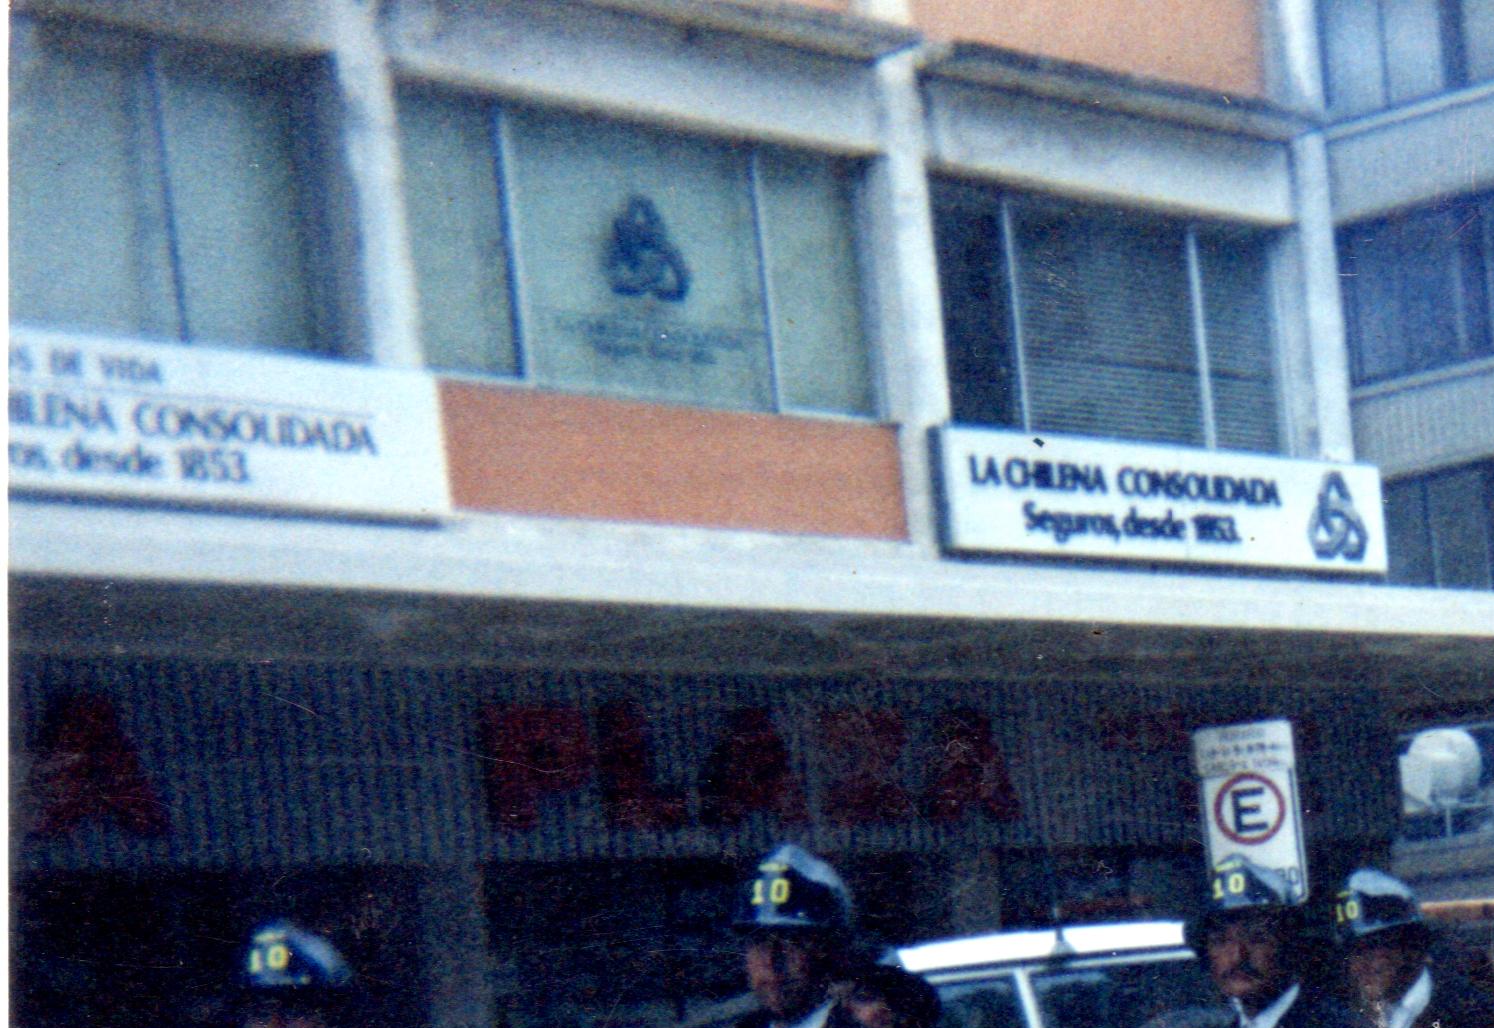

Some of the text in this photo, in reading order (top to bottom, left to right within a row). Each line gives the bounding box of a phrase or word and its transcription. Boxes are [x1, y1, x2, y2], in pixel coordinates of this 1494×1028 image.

[50, 349, 82, 377] DE
[99, 355, 162, 384] VIDA
[132, 401, 379, 456] CONSOLIDADA
[61, 438, 161, 478] desde
[968, 454, 1282, 508] LA CHILENA CONSOLIDADA
[1122, 507, 1186, 541] desde
[478, 699, 1022, 833] PLAZA
[1231, 787, 1268, 833] E
[752, 878, 790, 906] 10
[1213, 872, 1246, 900] 10
[1336, 900, 1359, 923] 10
[248, 944, 289, 974] 10
